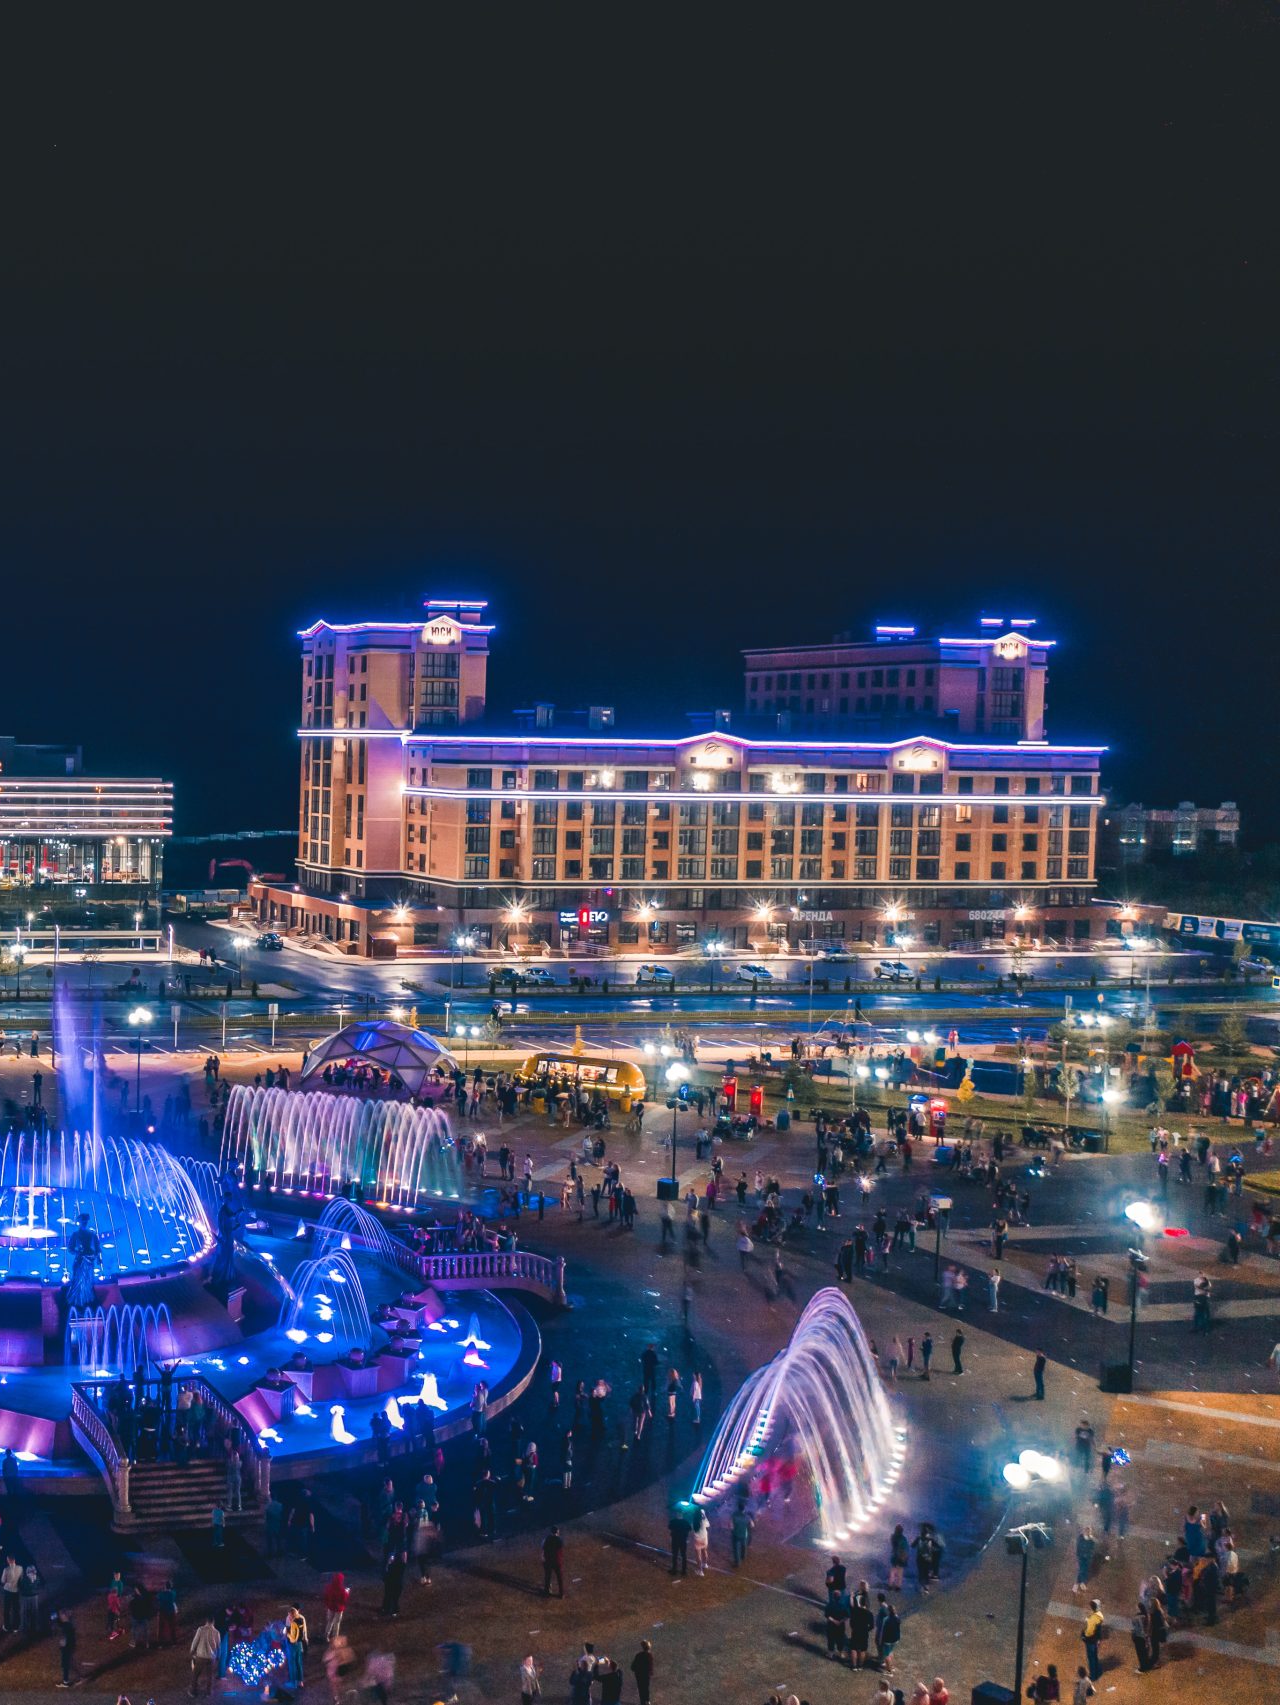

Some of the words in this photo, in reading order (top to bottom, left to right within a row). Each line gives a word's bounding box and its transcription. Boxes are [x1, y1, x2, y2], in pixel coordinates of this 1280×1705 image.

[431, 627, 452, 636] ЮСИ
[589, 911, 608, 921] EVO
[792, 911, 833, 921] АРЕНДА
[968, 910, 1005, 920] 680244
